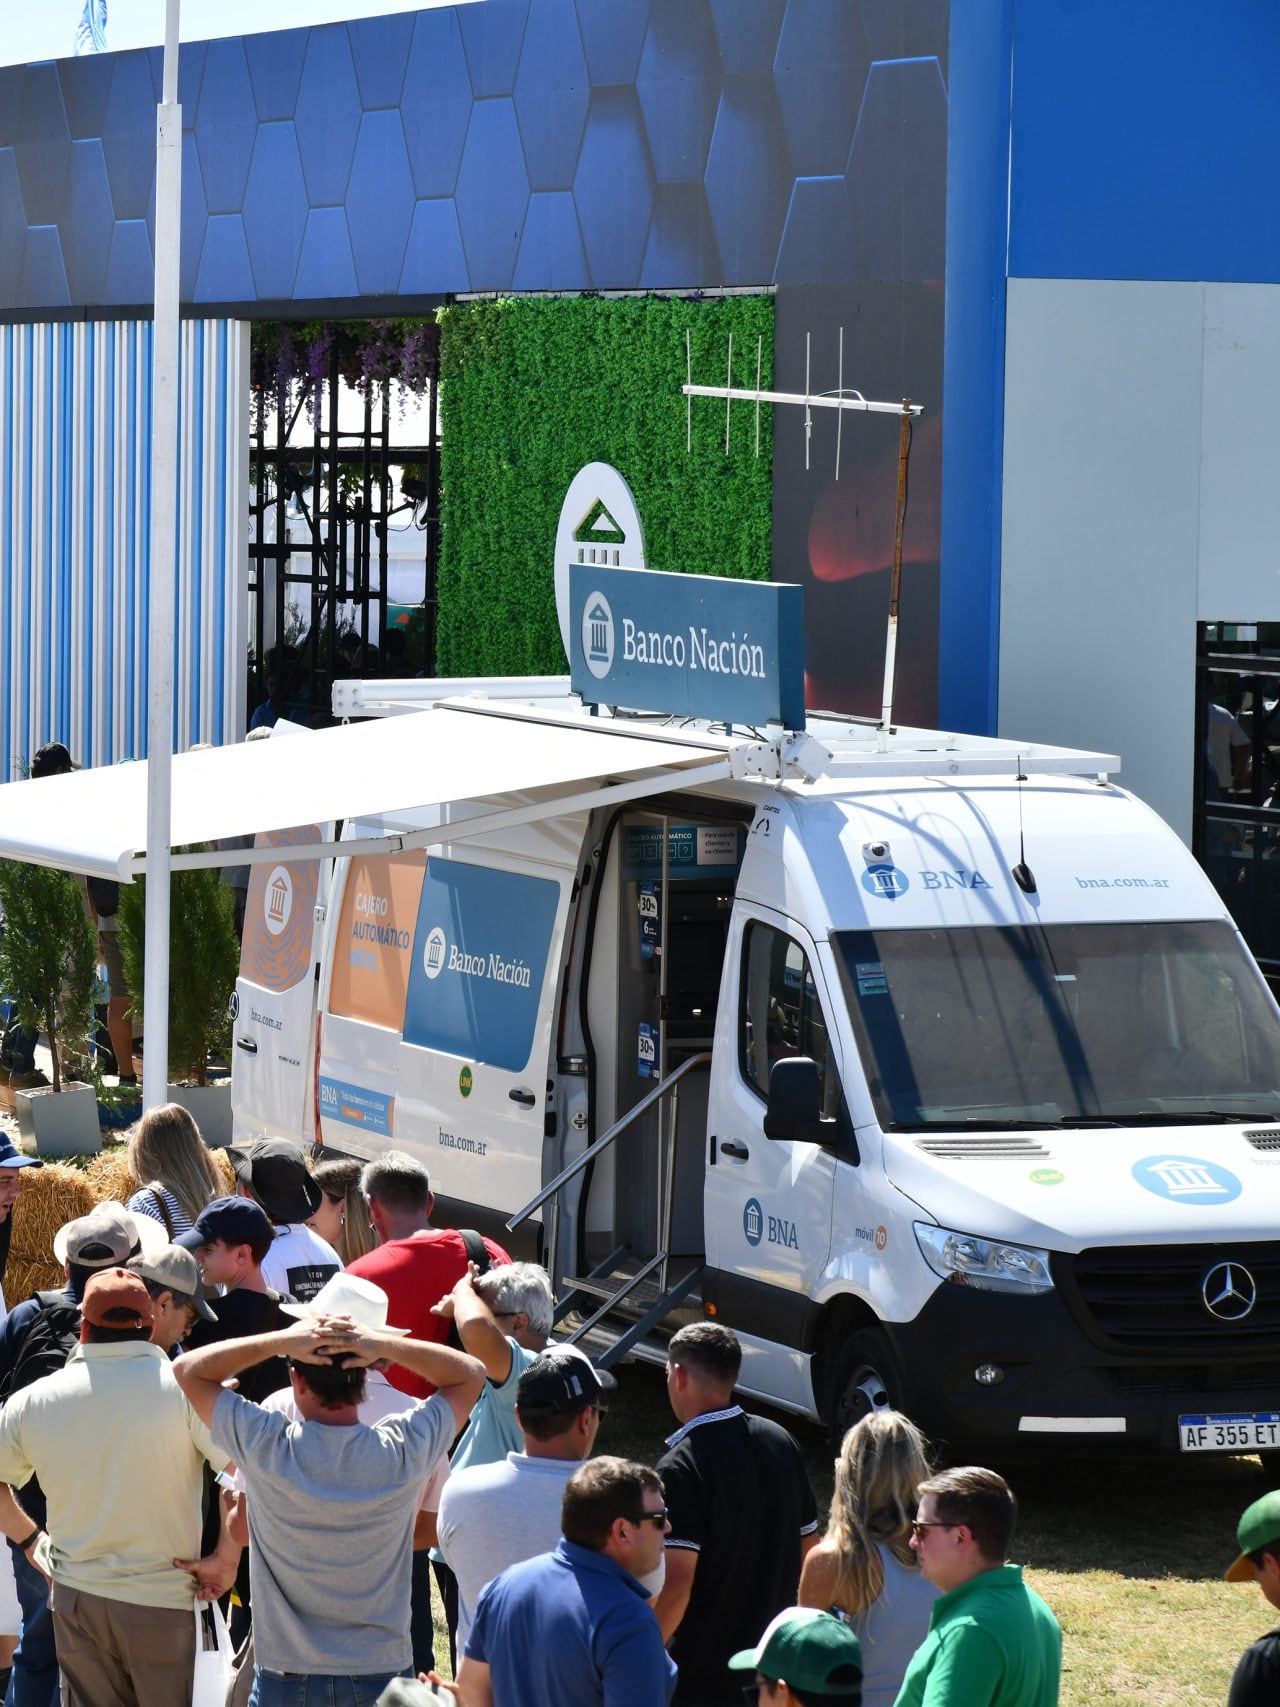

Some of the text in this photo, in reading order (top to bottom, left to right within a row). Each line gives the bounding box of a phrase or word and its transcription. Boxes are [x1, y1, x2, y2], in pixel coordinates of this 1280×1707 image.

[622, 618, 766, 678] Banco Nación
[918, 870, 994, 890] BNA
[1075, 876, 1170, 889] bna.com.ar
[355, 892, 388, 917] CAJERO
[352, 921, 410, 949] AUTOMÁTICO
[448, 944, 531, 988] Banco Nación
[251, 1007, 283, 1031] bna.com.ar
[321, 1084, 338, 1106] BNA
[438, 1126, 487, 1156] bna.com.ar
[768, 1215, 799, 1250] BNA
[855, 1226, 885, 1245] móvil 10
[1186, 1424, 1278, 1447] AF 355 ET
